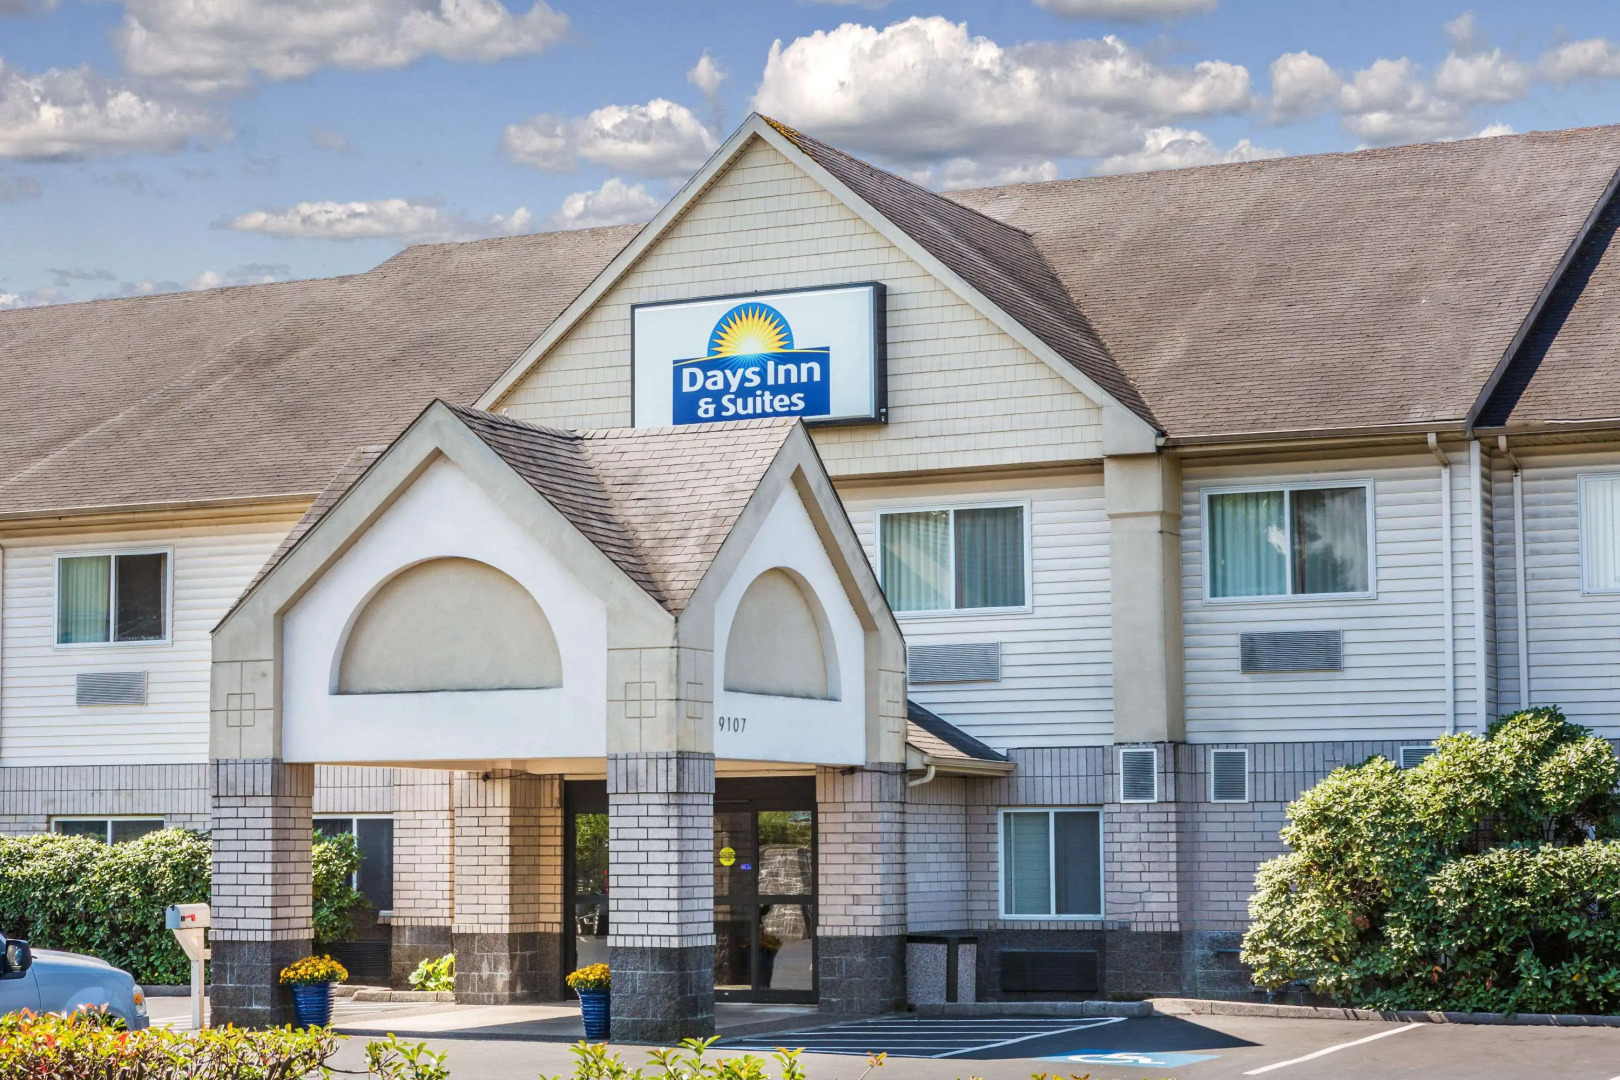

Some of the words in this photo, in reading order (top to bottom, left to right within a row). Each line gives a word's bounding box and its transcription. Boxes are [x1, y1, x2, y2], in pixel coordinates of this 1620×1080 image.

[682, 366, 760, 392] Days
[767, 360, 820, 385] Inn
[697, 397, 716, 418] &
[721, 390, 805, 416] Suites
[718, 716, 746, 733] 9107
